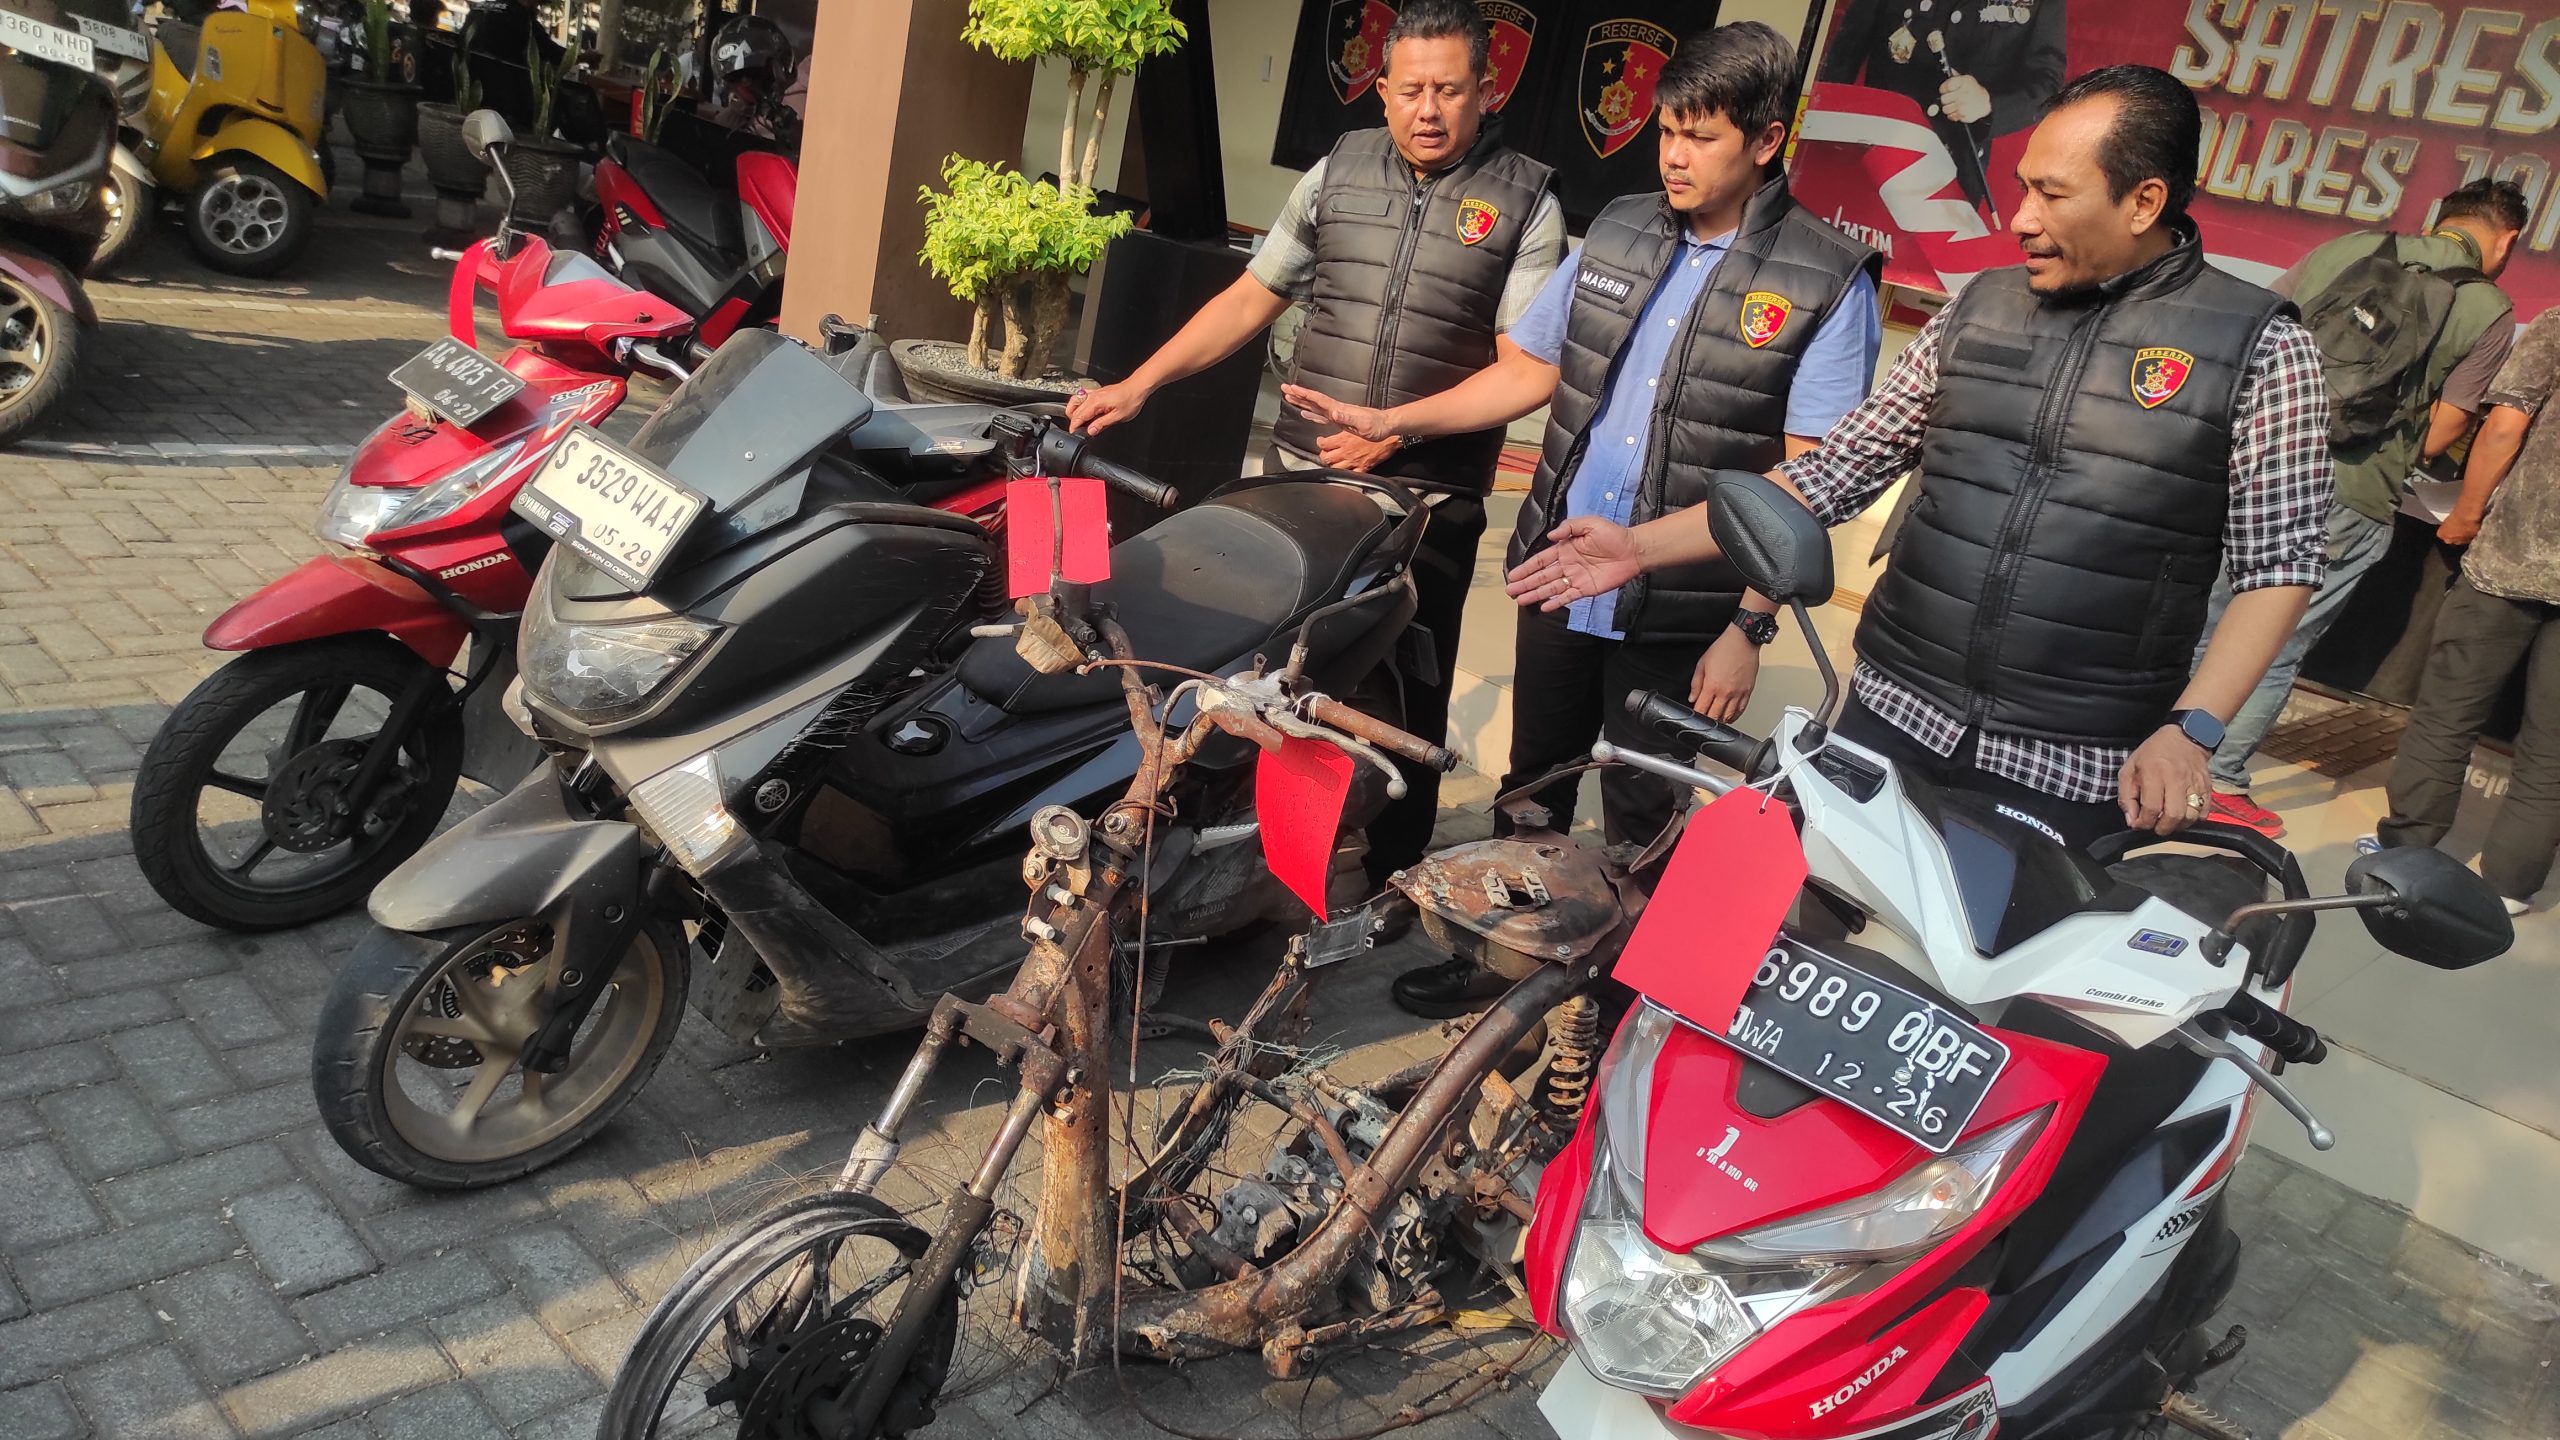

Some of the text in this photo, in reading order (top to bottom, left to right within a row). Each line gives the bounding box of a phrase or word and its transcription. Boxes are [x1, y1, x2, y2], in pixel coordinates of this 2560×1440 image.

[0, 15, 42, 39] 360
[1478, 1, 1527, 25] ESERSE
[1601, 24, 1665, 48] RESERSE
[1580, 270, 1630, 298] MAGRIBI
[450, 354, 493, 387] 4825
[2142, 350, 2190, 364] RESERSE
[554, 440, 686, 537] S 3529 WAA
[524, 496, 552, 522] YAMAHA
[439, 552, 511, 580] HONDA
[571, 539, 605, 564] SEMAKIN
[612, 565, 640, 586] DEPAN
[1995, 803, 2067, 847] HONDA
[1751, 948, 1882, 1033] 6989
[2084, 986, 2166, 1009] Combi Brake
[1808, 1345, 1910, 1421] HONDA
